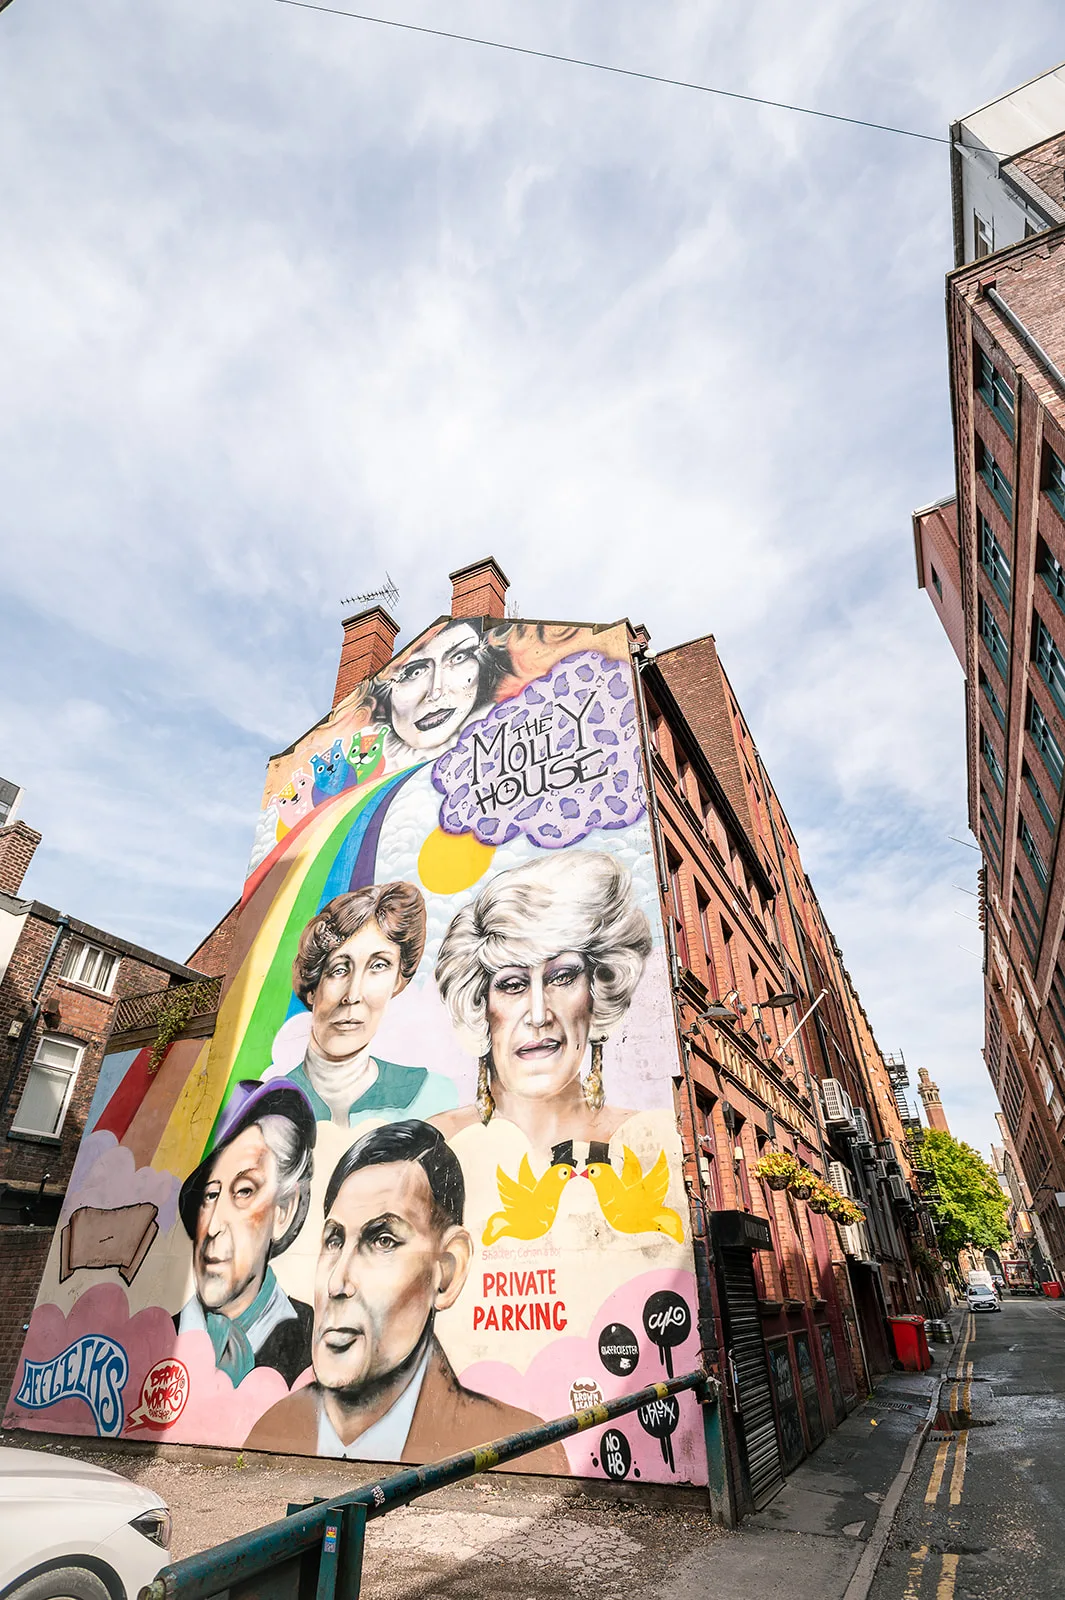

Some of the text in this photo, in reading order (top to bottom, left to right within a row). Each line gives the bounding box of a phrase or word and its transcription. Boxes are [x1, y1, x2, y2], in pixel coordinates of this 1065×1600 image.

[471, 690, 597, 787] MOLLY
[513, 717, 552, 740] THE
[475, 749, 609, 815] HOUSE
[483, 1269, 556, 1298] PRIVATE
[473, 1301, 567, 1331] PARKING
[19, 1339, 124, 1432] AFFLECKS
[574, 1392, 599, 1402] BROWN
[606, 1433, 620, 1452] NO
[607, 1452, 626, 1476] H8
